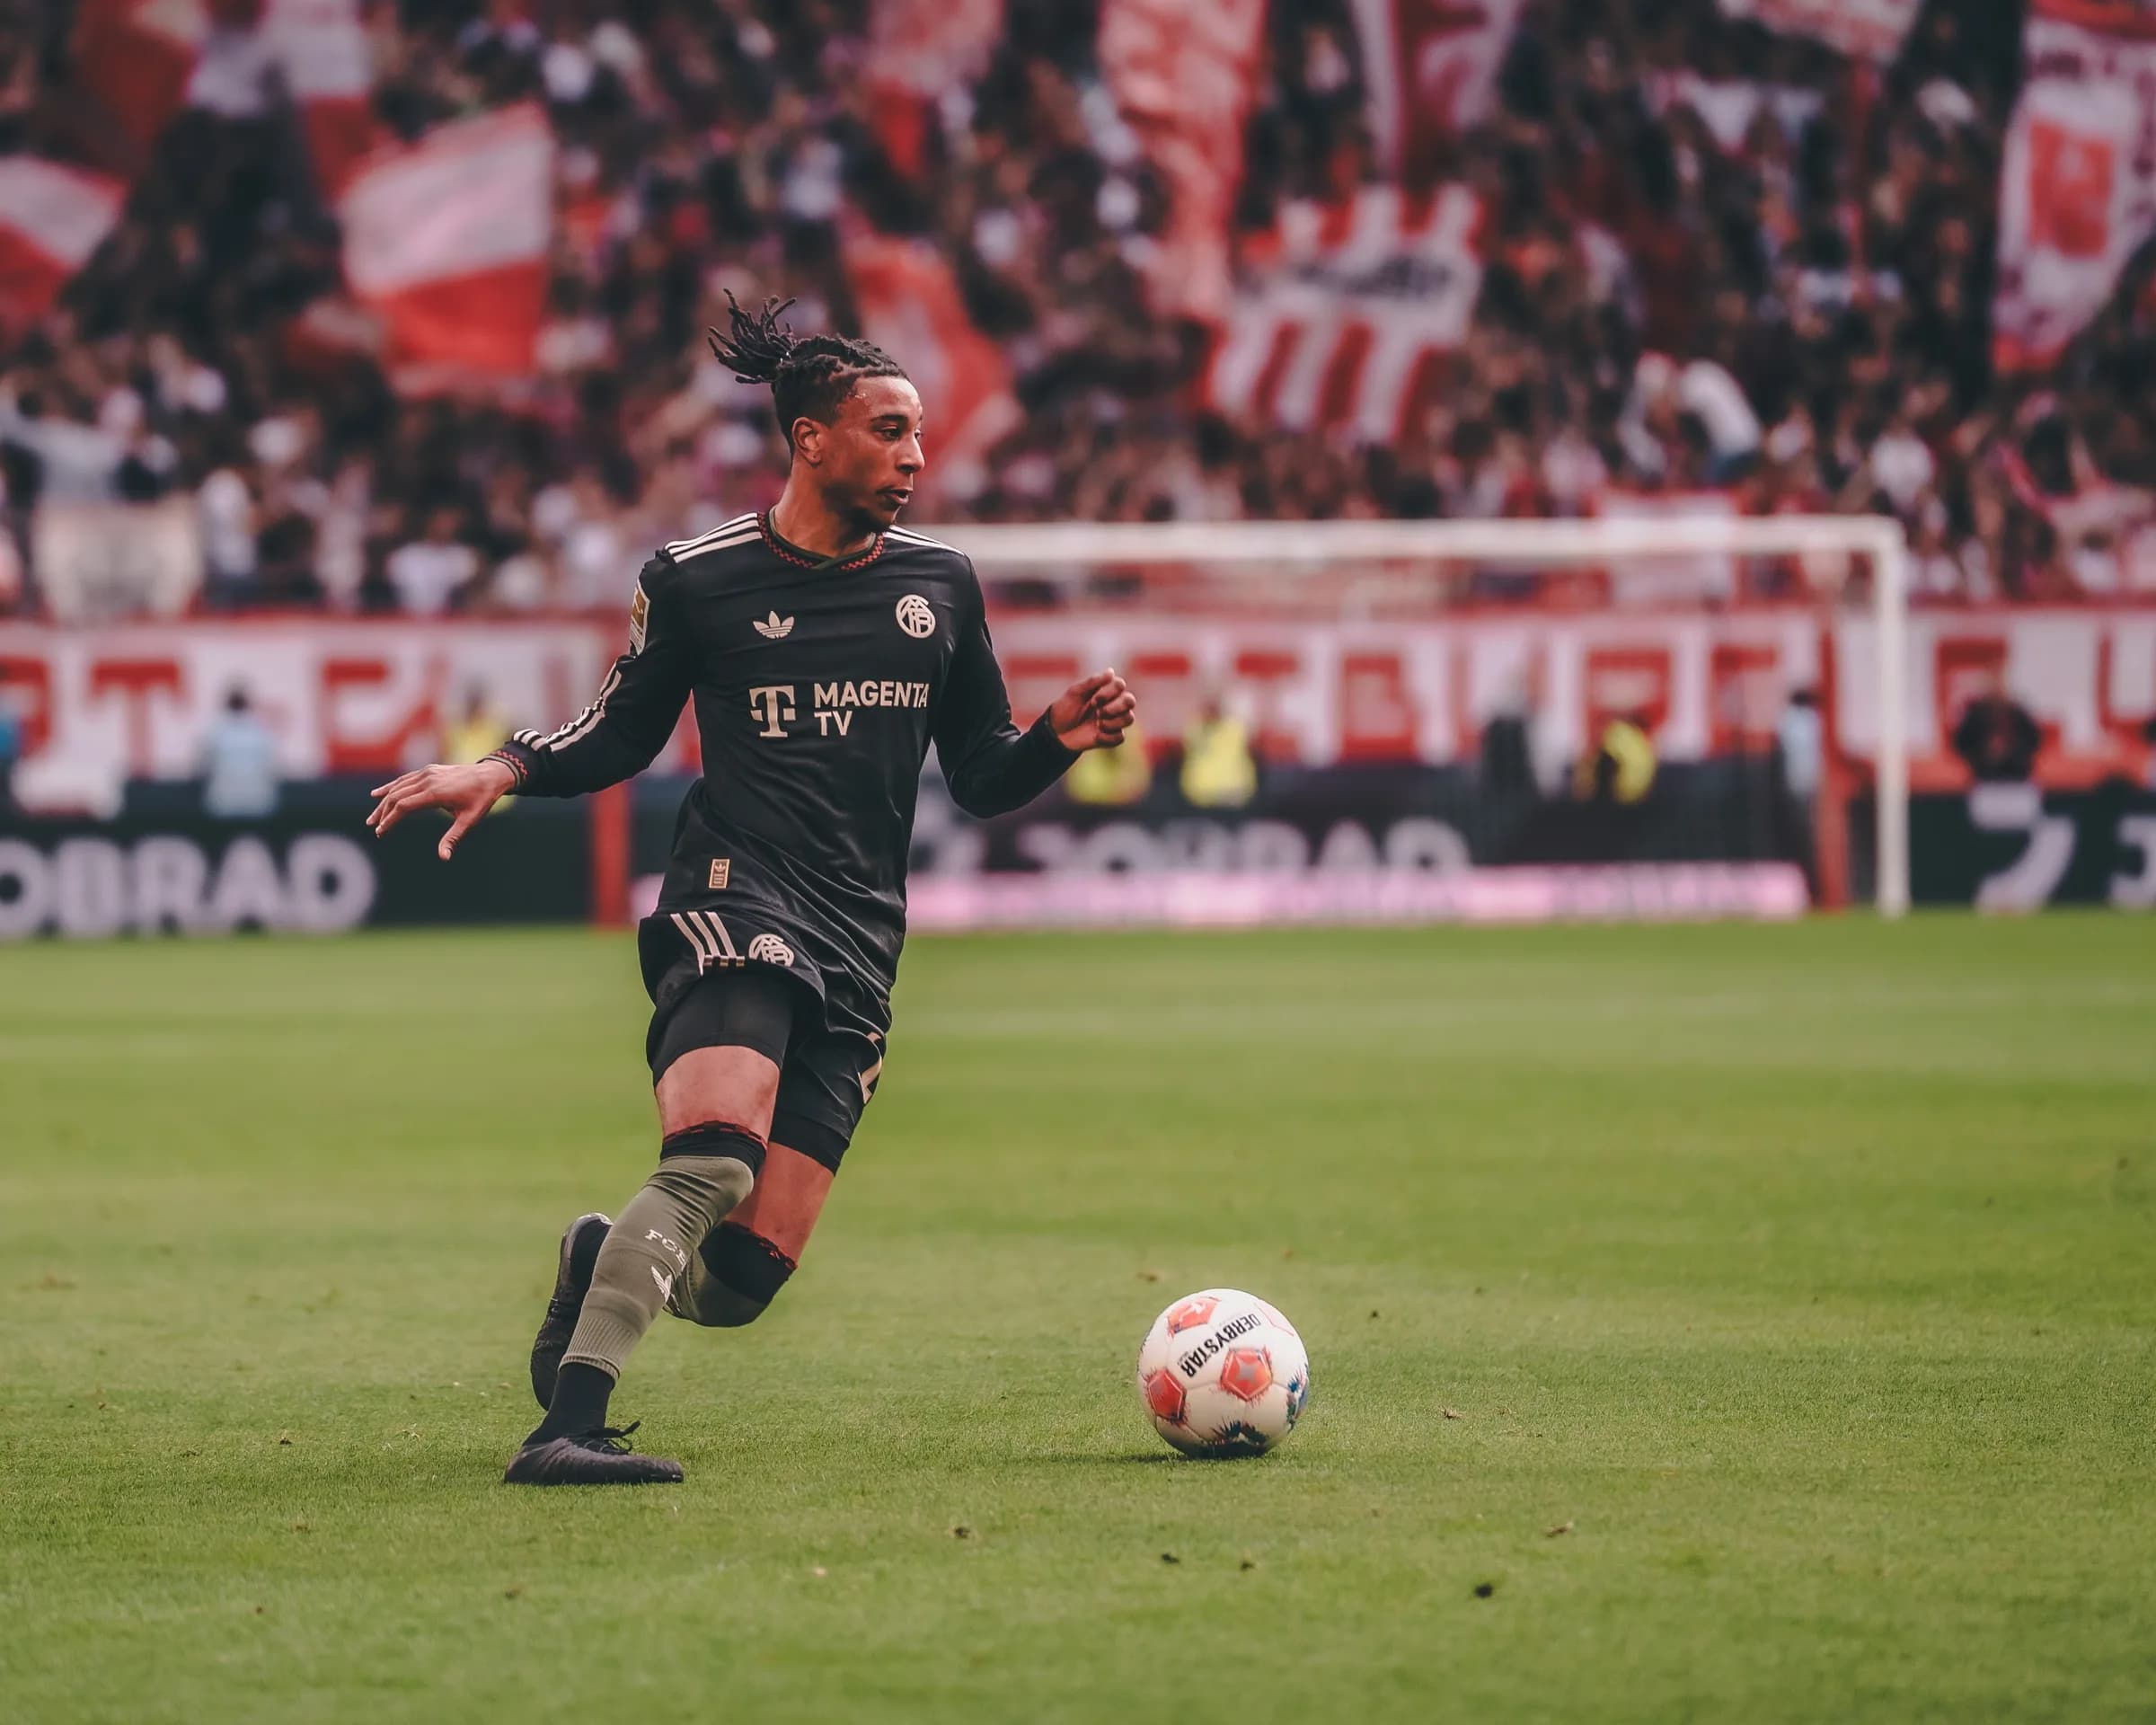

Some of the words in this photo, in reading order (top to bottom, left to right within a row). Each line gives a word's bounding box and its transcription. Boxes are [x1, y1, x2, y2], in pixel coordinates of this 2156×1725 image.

[814, 680, 930, 708] MAGENTA
[814, 710, 853, 737] TV
[1180, 1313, 1262, 1378] DERBYSTAR
